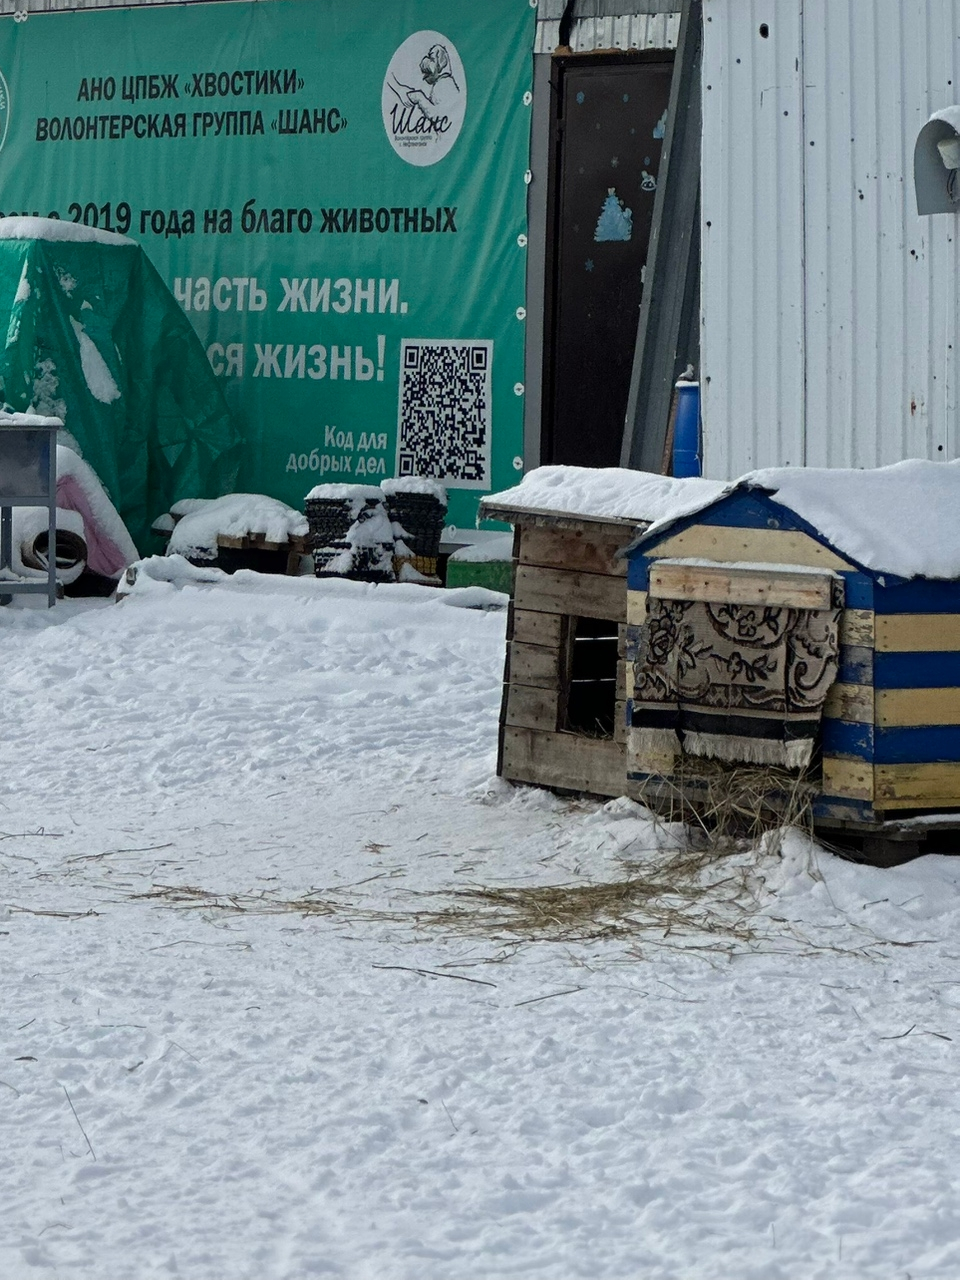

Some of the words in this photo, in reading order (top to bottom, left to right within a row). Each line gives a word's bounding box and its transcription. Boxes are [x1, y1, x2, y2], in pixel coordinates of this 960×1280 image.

[77, 76, 116, 102] АНО
[122, 74, 180, 104] ЦПБЖ
[184, 68, 305, 97] «ХВОСТИКИ»
[35, 112, 187, 141] ВОЛОНТЕРСКАЯ
[192, 109, 265, 137] ГРУППА
[271, 107, 348, 135] «ШАНС»
[390, 103, 452, 135] Шанс
[68, 201, 131, 234] 2019
[140, 208, 195, 239] года
[203, 207, 233, 233] на
[241, 198, 313, 233] благо
[320, 206, 458, 233] животных
[173, 276, 268, 312] часть
[276, 277, 409, 314] жизни.
[252, 334, 386, 382] жизнь!
[324, 425, 354, 451] Код
[357, 432, 388, 451] для
[286, 449, 352, 475] добрых
[355, 456, 387, 474] дел
